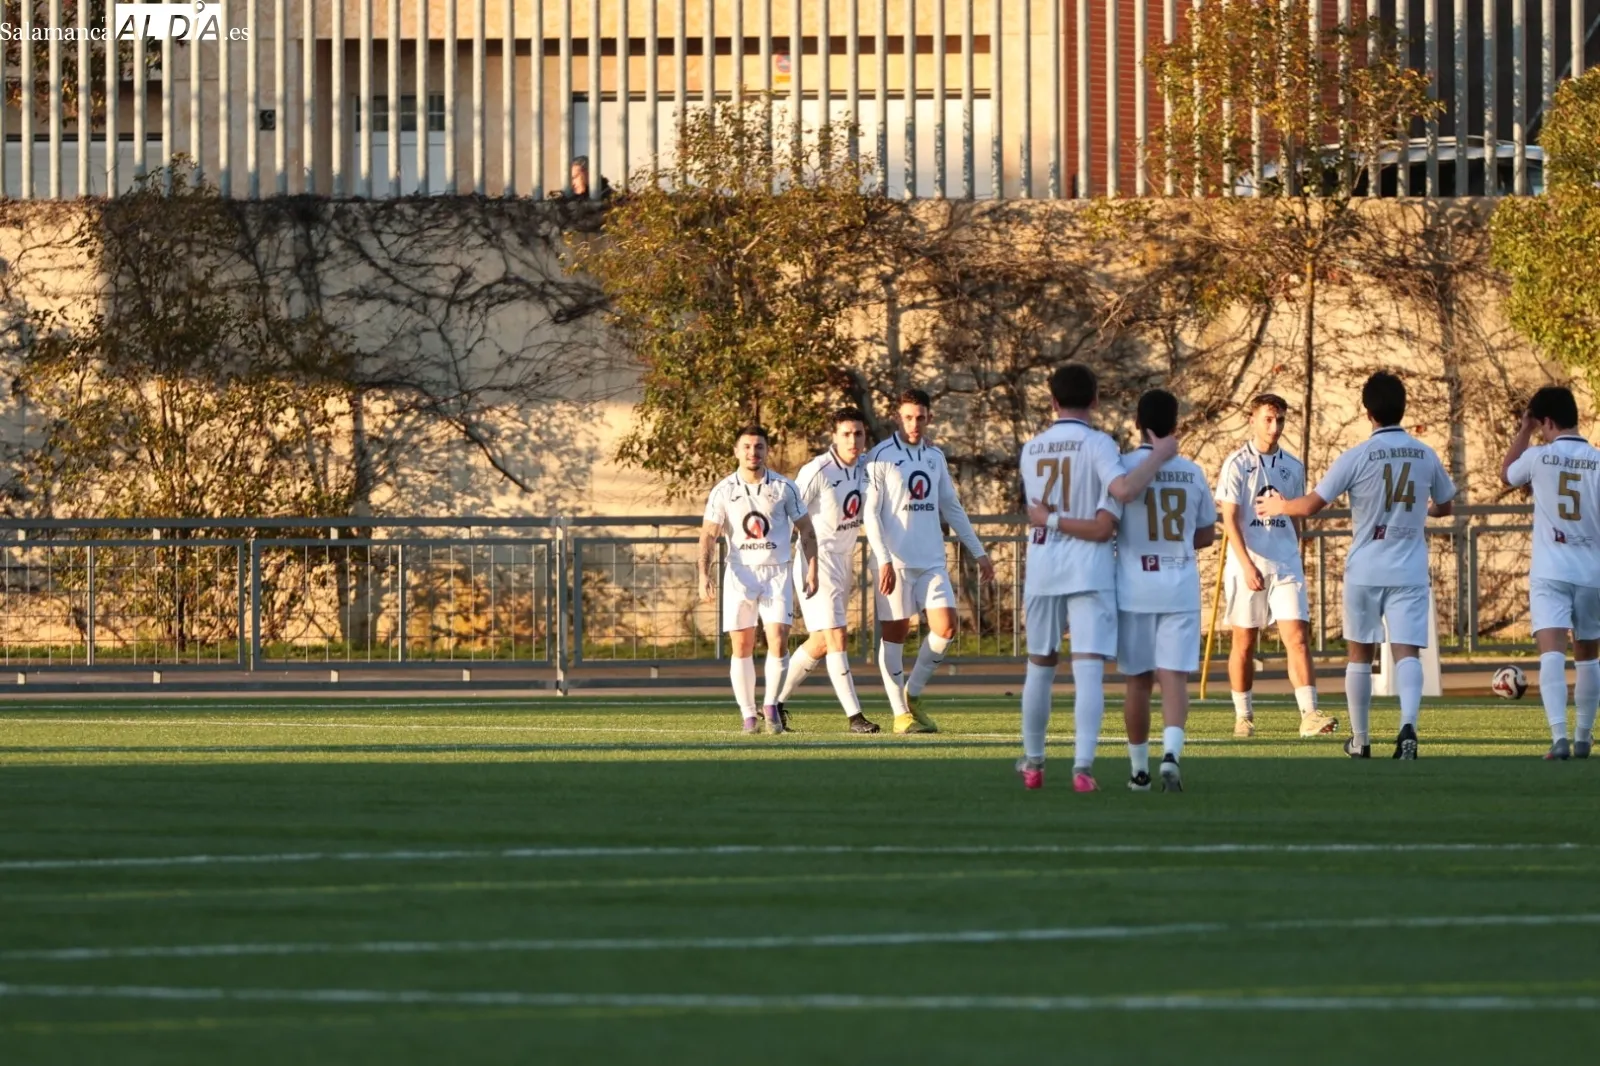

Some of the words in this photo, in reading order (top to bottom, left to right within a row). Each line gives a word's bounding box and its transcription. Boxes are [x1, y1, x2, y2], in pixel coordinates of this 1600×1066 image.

[1048, 440, 1084, 453] RIBERT
[1369, 449, 1389, 461] C.D.
[1390, 447, 1425, 460] RIBERT
[1542, 454, 1562, 466] C.D.
[1564, 456, 1600, 471] RIBERT
[1036, 456, 1071, 513] 21
[1155, 470, 1196, 484] RIBERT
[1382, 461, 1416, 513] 14
[1558, 470, 1582, 521] 5
[902, 502, 935, 512] ANDRÉS
[1144, 487, 1187, 542] 18
[739, 541, 777, 551] ANDRÉS
